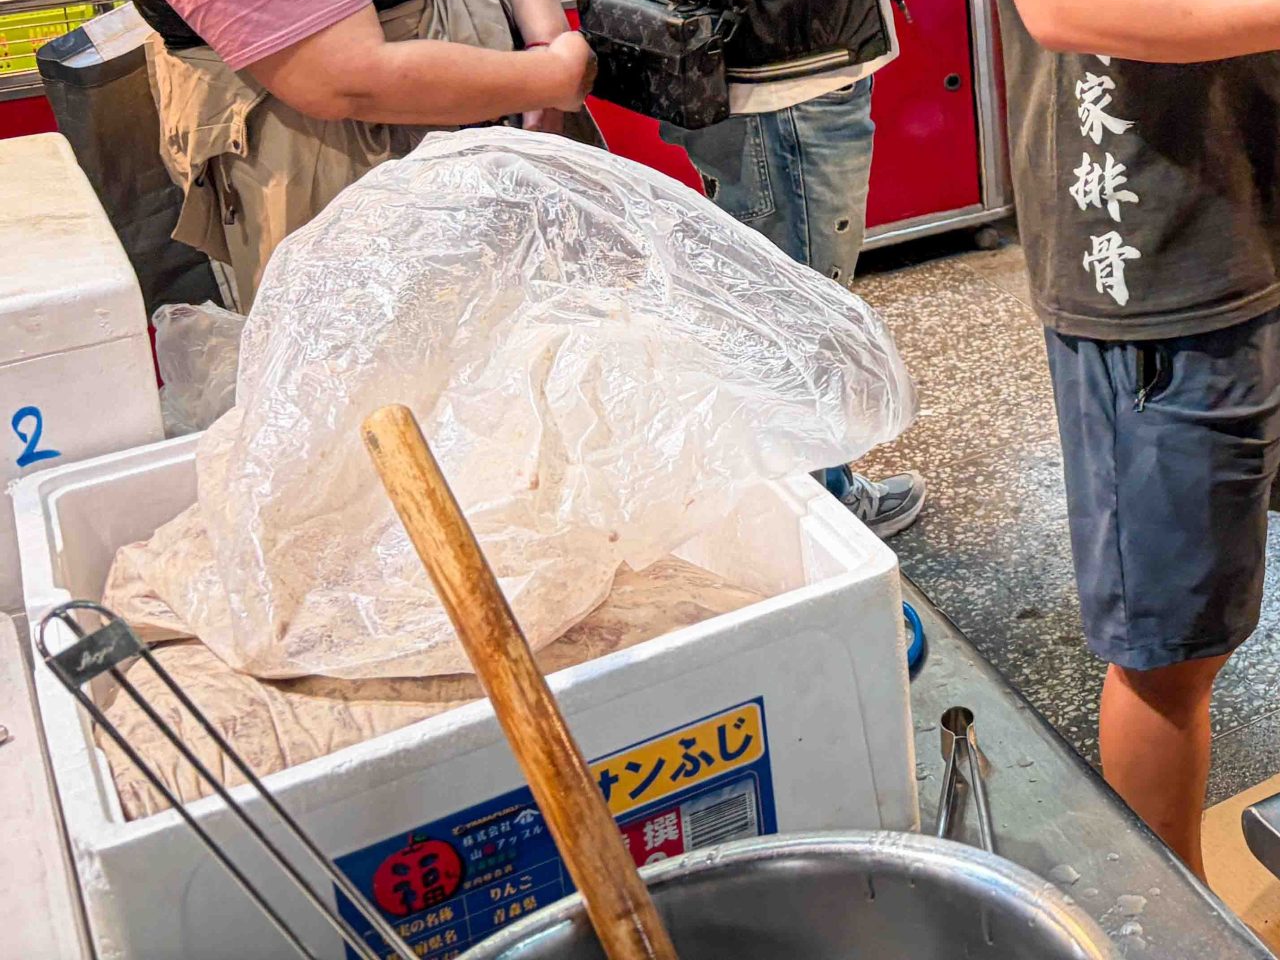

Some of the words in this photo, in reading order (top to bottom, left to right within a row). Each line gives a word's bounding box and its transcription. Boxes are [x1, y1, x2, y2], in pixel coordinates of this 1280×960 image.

[1068, 54, 1142, 307] 家排骨
[12, 406, 62, 468] 2
[490, 875, 533, 901] りんご
